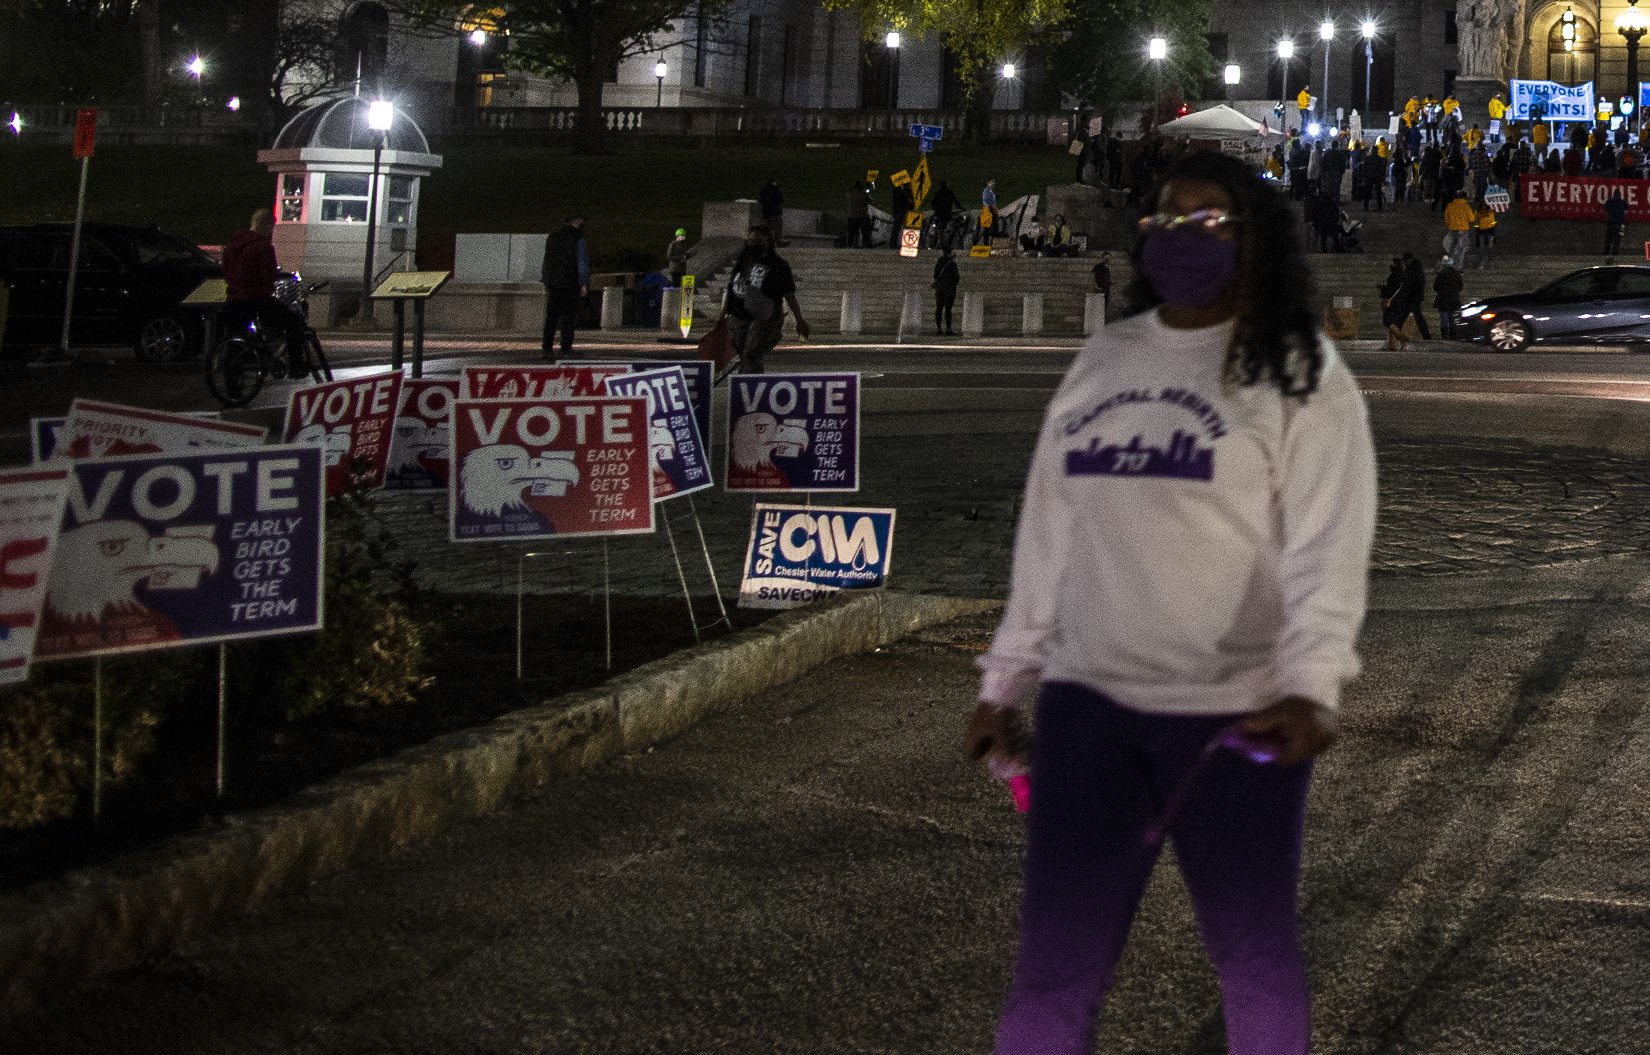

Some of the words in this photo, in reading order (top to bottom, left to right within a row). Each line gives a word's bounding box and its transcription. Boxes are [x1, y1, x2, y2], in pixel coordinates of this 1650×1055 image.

[1519, 84, 1584, 97] EVERYONE
[299, 378, 394, 428] VOTE
[739, 380, 847, 415] VOTE
[73, 418, 149, 438] PRIORITY
[356, 417, 389, 434] EARLY
[467, 404, 634, 447] VOTE
[813, 418, 849, 430] EARLY
[356, 430, 381, 448] BIRD
[814, 431, 844, 443] BIRD
[585, 447, 637, 463] EARLY
[814, 443, 844, 455] GETS
[590, 462, 630, 477] BIRD
[817, 456, 839, 468] THE
[812, 469, 847, 482] TERM
[66, 457, 301, 524] VOTE
[590, 477, 631, 492] GETS
[593, 492, 625, 507] THE
[588, 507, 637, 523] TERM
[230, 516, 303, 540] EARLY
[235, 537, 291, 560] BIRD
[755, 512, 781, 575] SAVE
[233, 557, 292, 580] GETS
[774, 565, 809, 577] Chester
[811, 566, 836, 578] Water
[837, 568, 879, 581] Authority
[240, 578, 284, 601] THE
[230, 598, 298, 623] TERM
